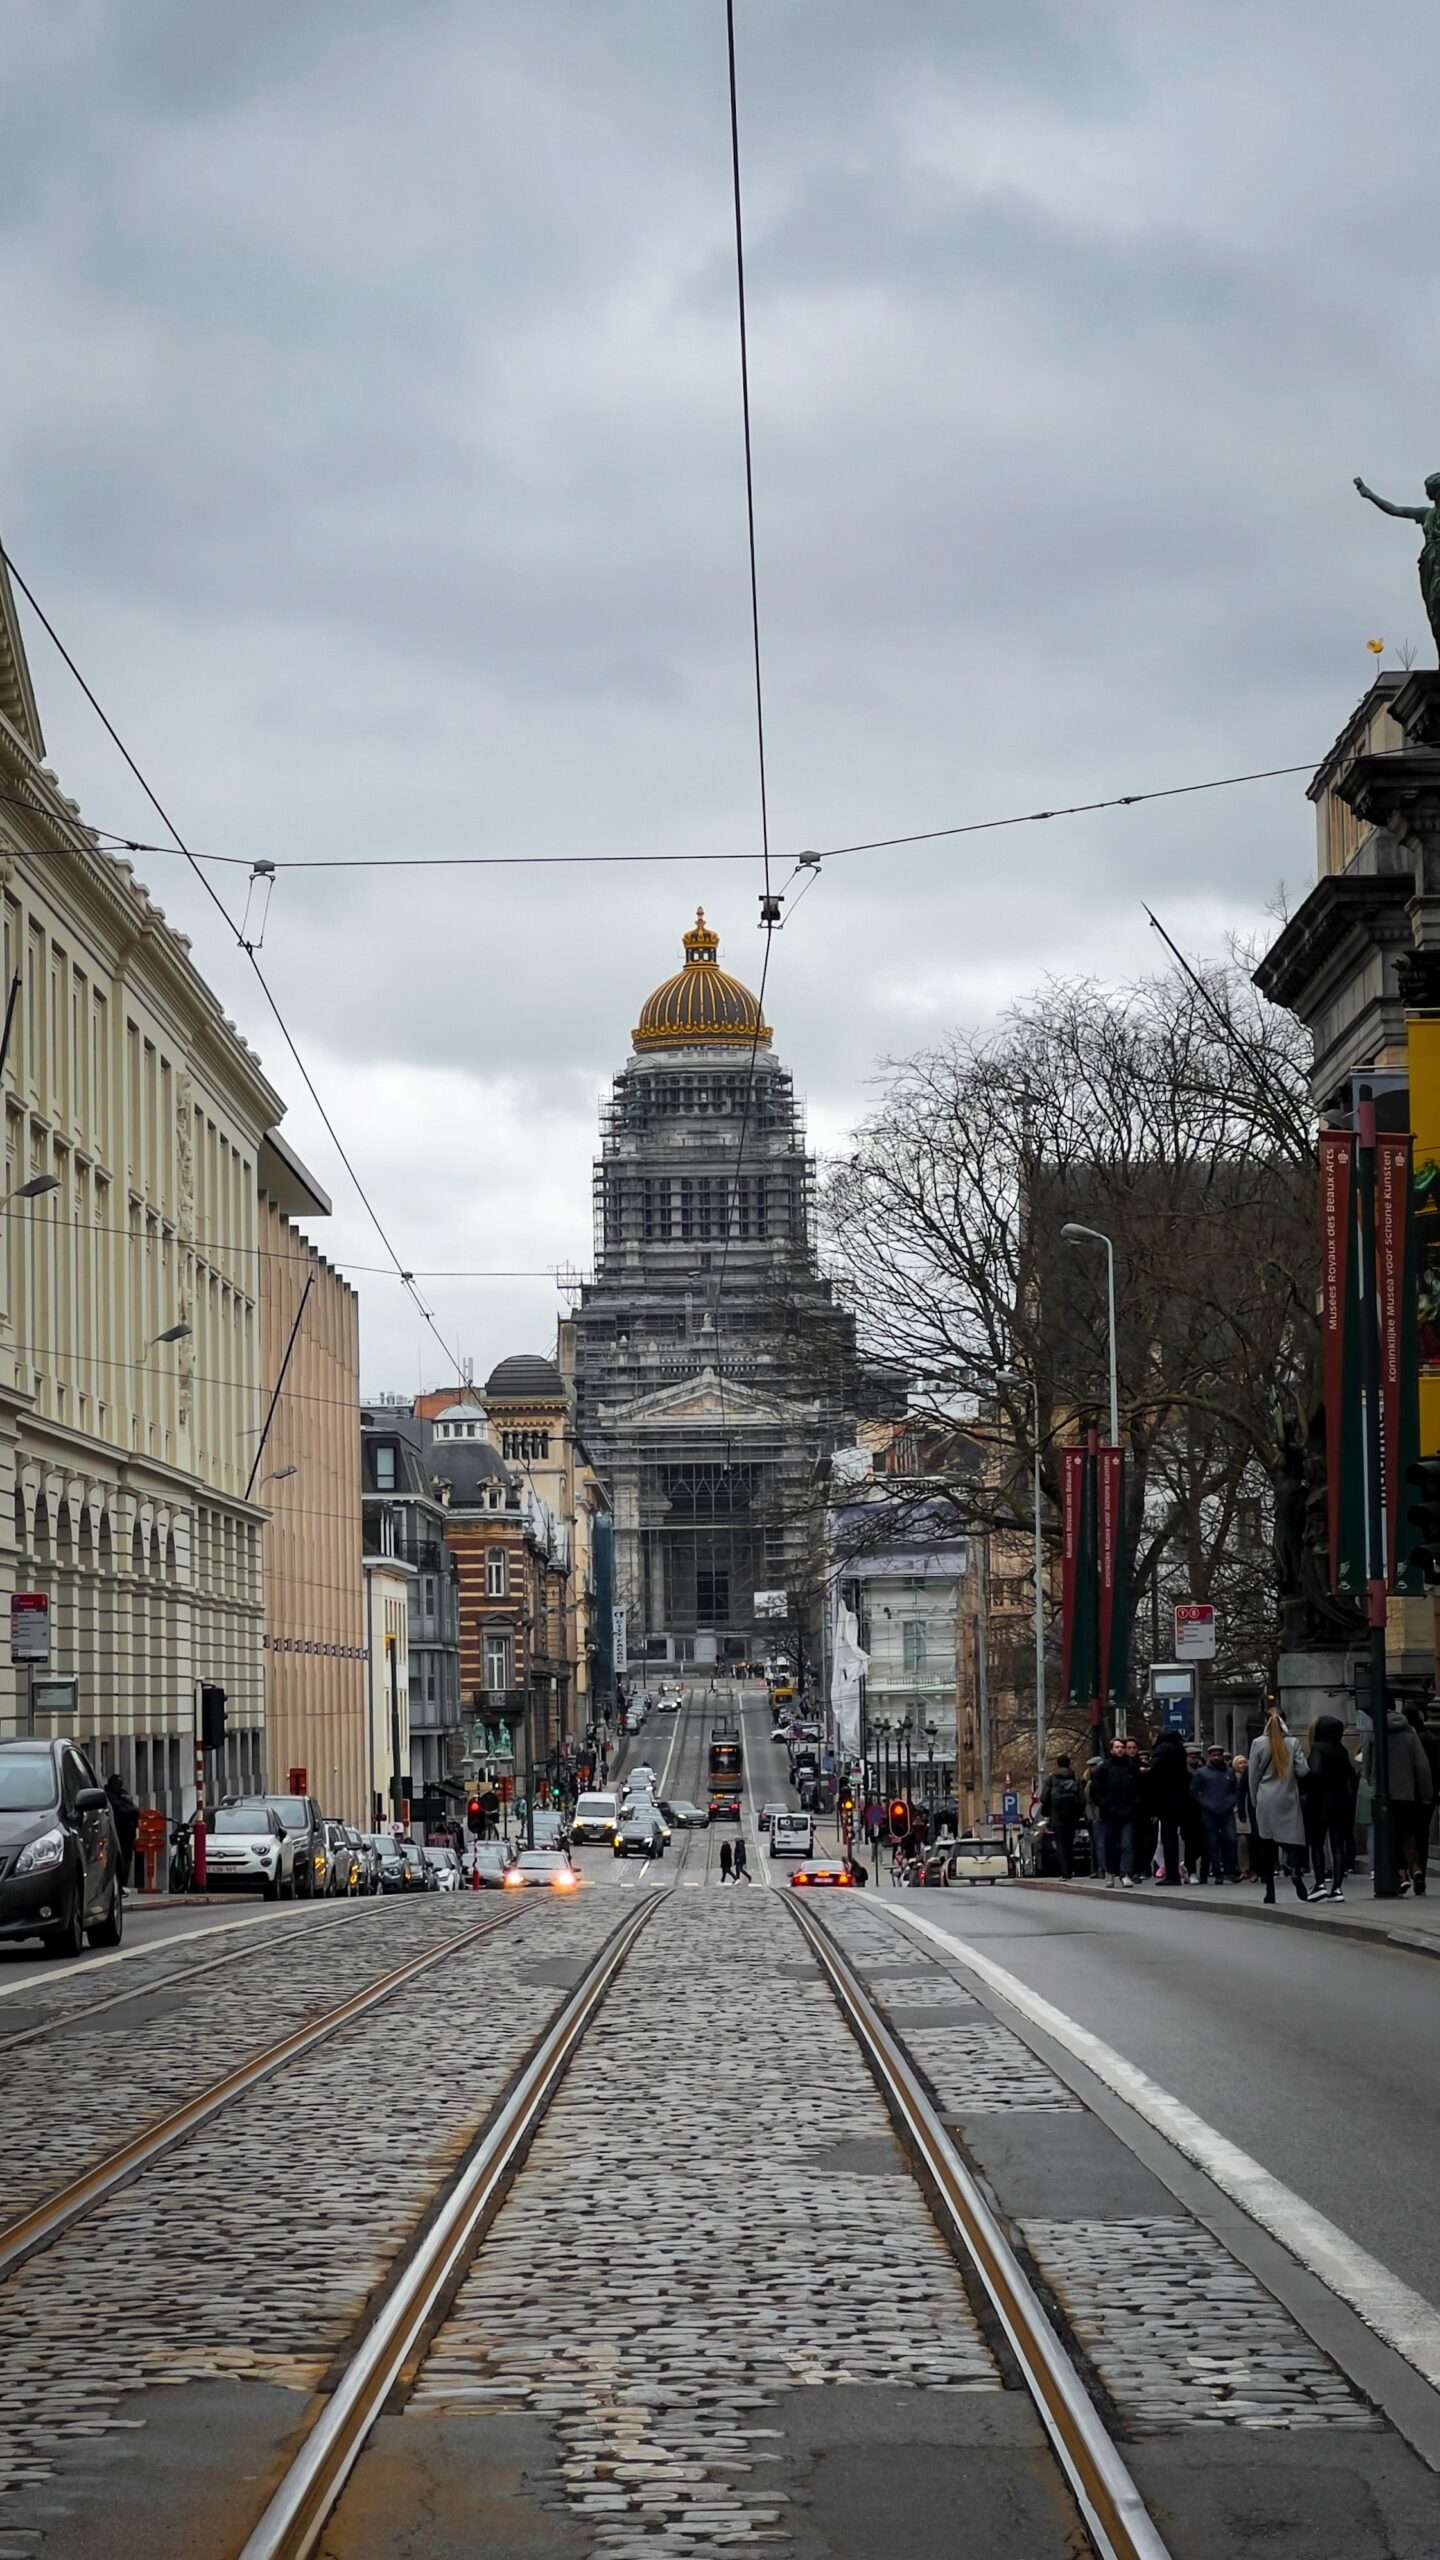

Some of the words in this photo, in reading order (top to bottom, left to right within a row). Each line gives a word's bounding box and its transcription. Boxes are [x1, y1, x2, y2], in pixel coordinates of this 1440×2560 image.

[1382, 1151, 1392, 1199] Kunsten
[1326, 1215, 1336, 1237] des
[1327, 1240, 1337, 1283] Royaux
[1384, 1248, 1394, 1276] voor
[1327, 1286, 1337, 1330] Musées
[1385, 1278, 1395, 1316] Musea
[1386, 1319, 1397, 1383] Koninklijke
[1004, 1795, 1016, 1812] P
